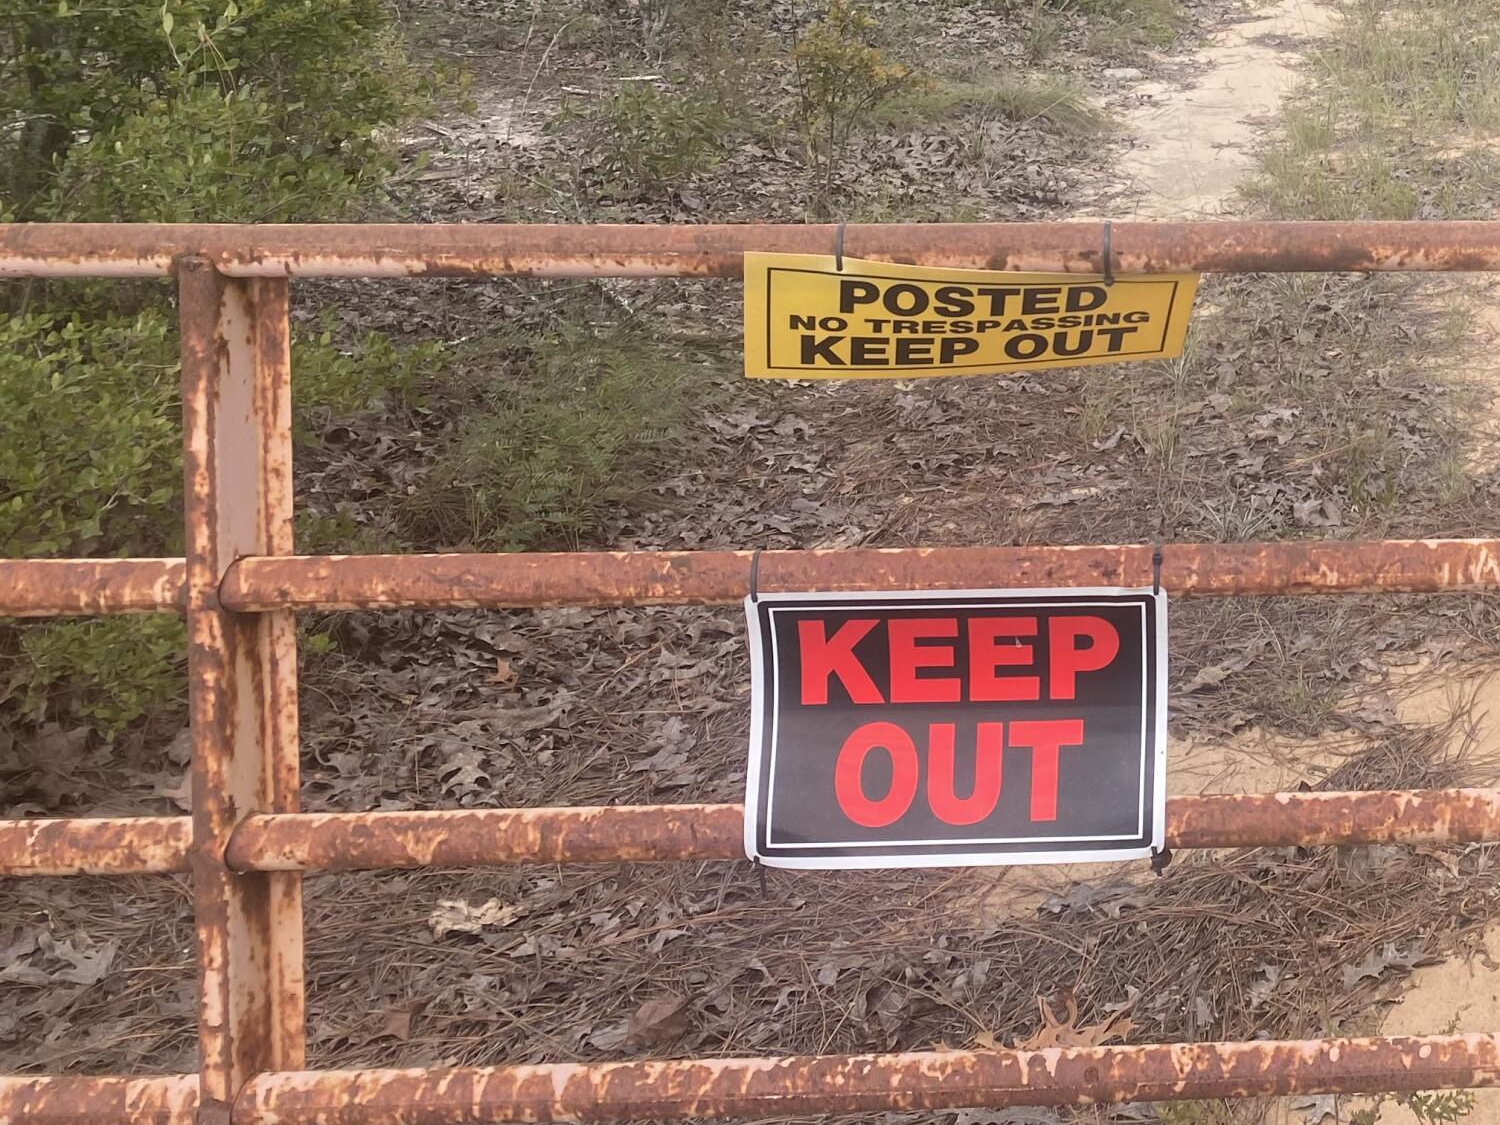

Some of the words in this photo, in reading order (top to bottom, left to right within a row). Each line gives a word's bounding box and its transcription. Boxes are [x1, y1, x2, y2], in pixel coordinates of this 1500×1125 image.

[839, 279, 1107, 317] POSTED
[789, 315, 848, 332] NO
[865, 310, 1150, 334] TRESPASSING
[800, 335, 979, 366] KEEP
[1004, 326, 1138, 360] OUT
[798, 615, 1120, 705] KEEP
[834, 720, 1084, 828] OUT
